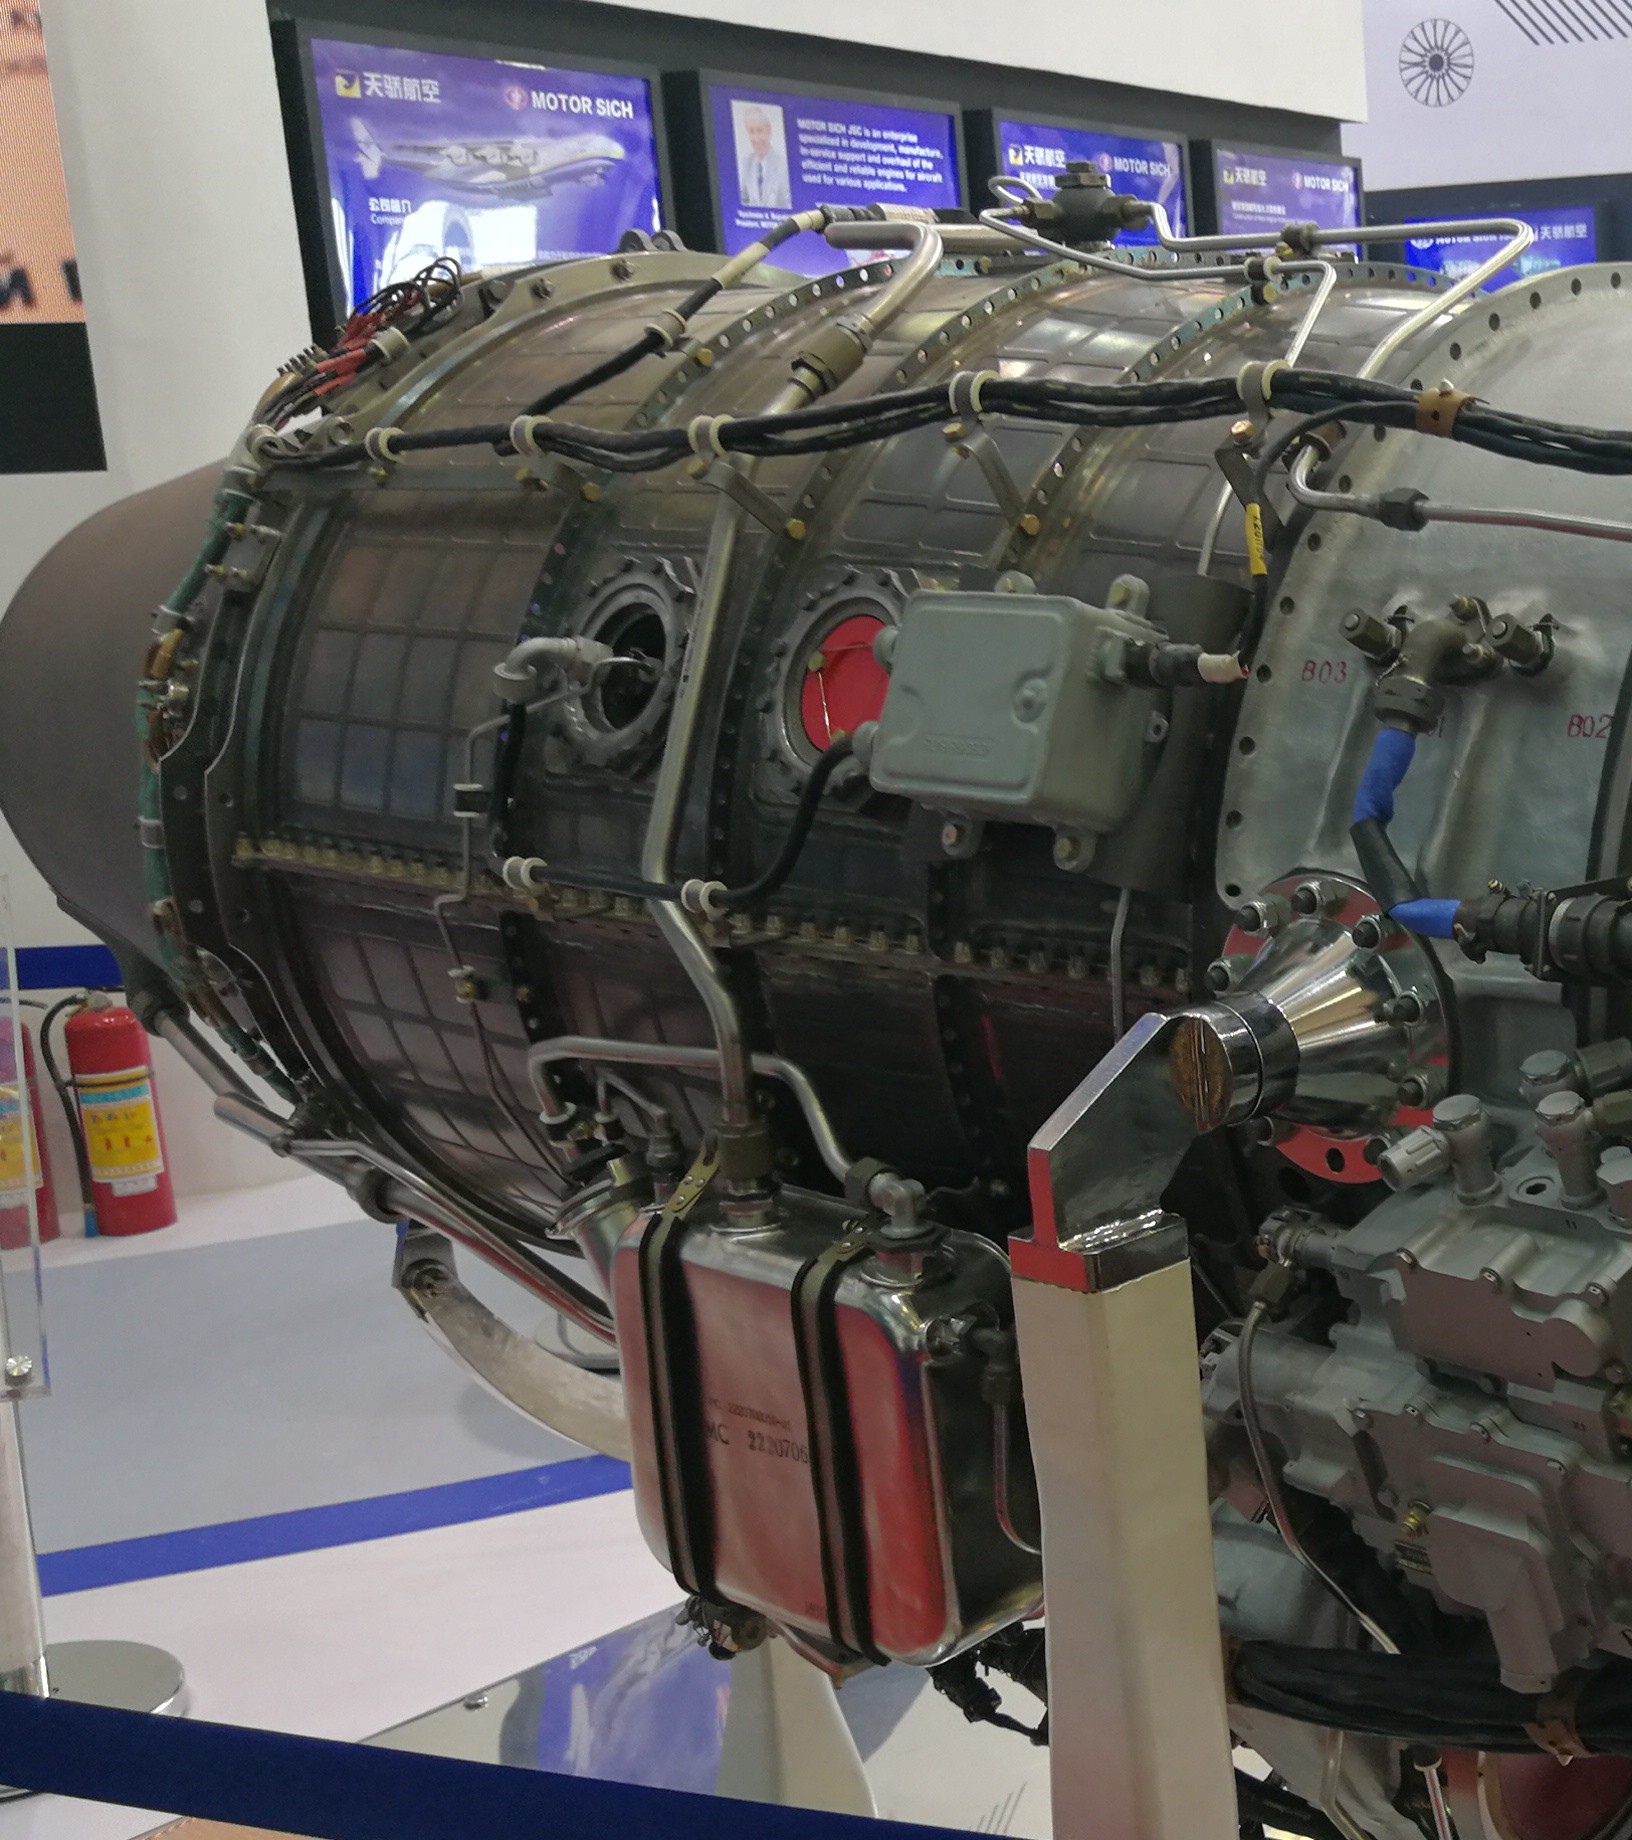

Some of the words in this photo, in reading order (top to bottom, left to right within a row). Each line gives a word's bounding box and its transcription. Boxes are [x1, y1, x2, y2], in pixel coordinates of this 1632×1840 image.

[363, 71, 441, 103] 天骄航空
[531, 91, 594, 115] MOTOR
[596, 98, 635, 119] SICH
[797, 118, 826, 131] MOTOR
[1113, 157, 1148, 174] MOTOR
[1149, 161, 1171, 176] SICH
[1303, 175, 1331, 191] MOTOR
[1332, 177, 1349, 192] SICH
